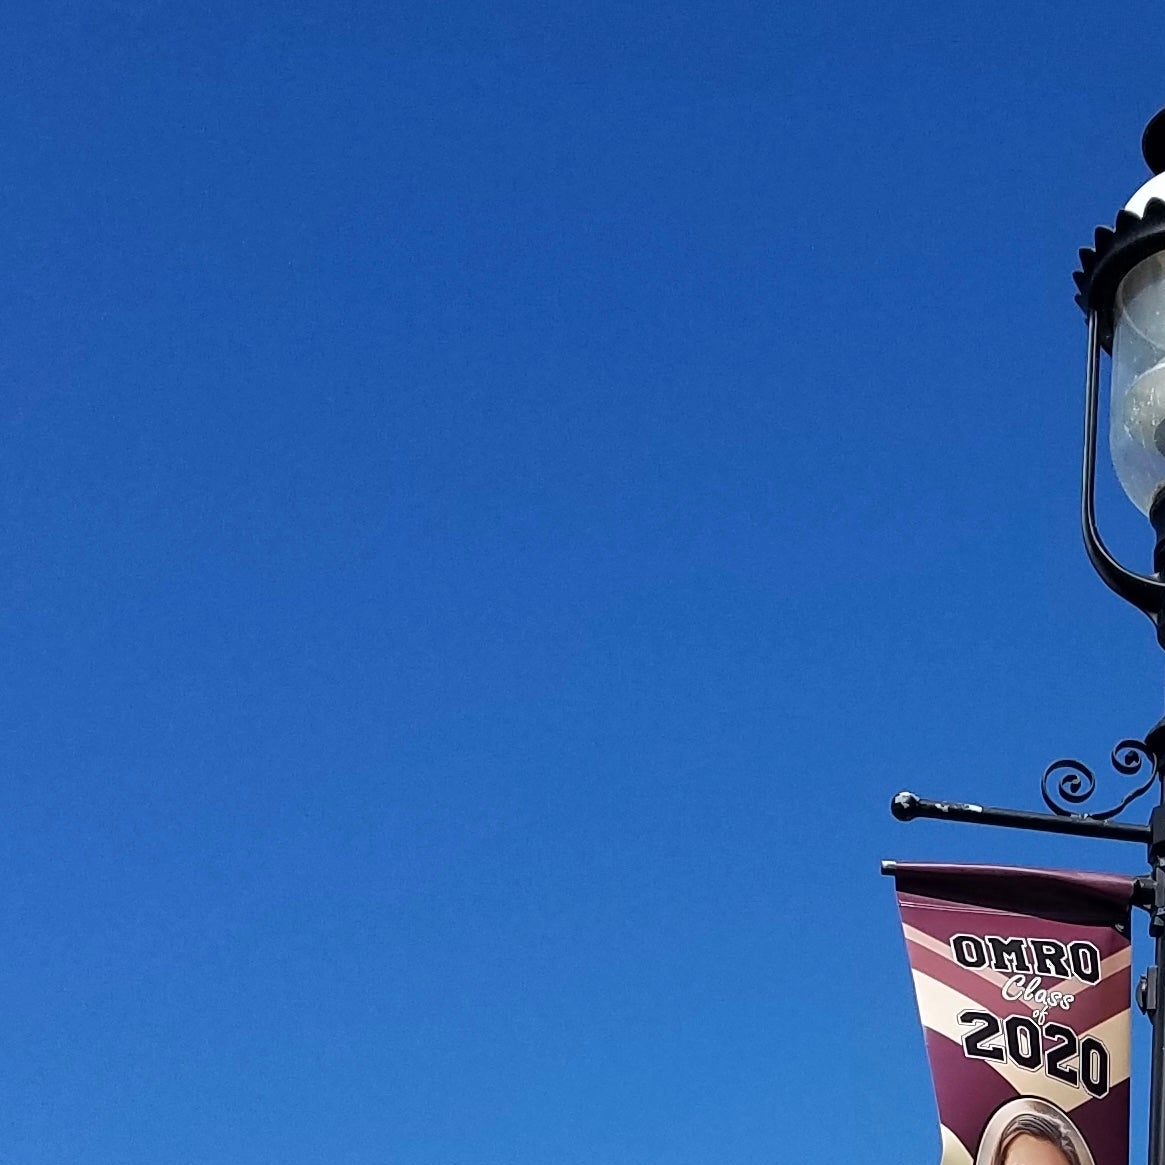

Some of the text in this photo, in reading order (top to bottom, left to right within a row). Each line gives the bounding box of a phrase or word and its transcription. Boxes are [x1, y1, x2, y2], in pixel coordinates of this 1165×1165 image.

[950, 934, 1101, 985] OMRO
[1001, 975, 1075, 1010] Class
[1032, 1005, 1049, 1025] of
[958, 1010, 1110, 1099] 2020
